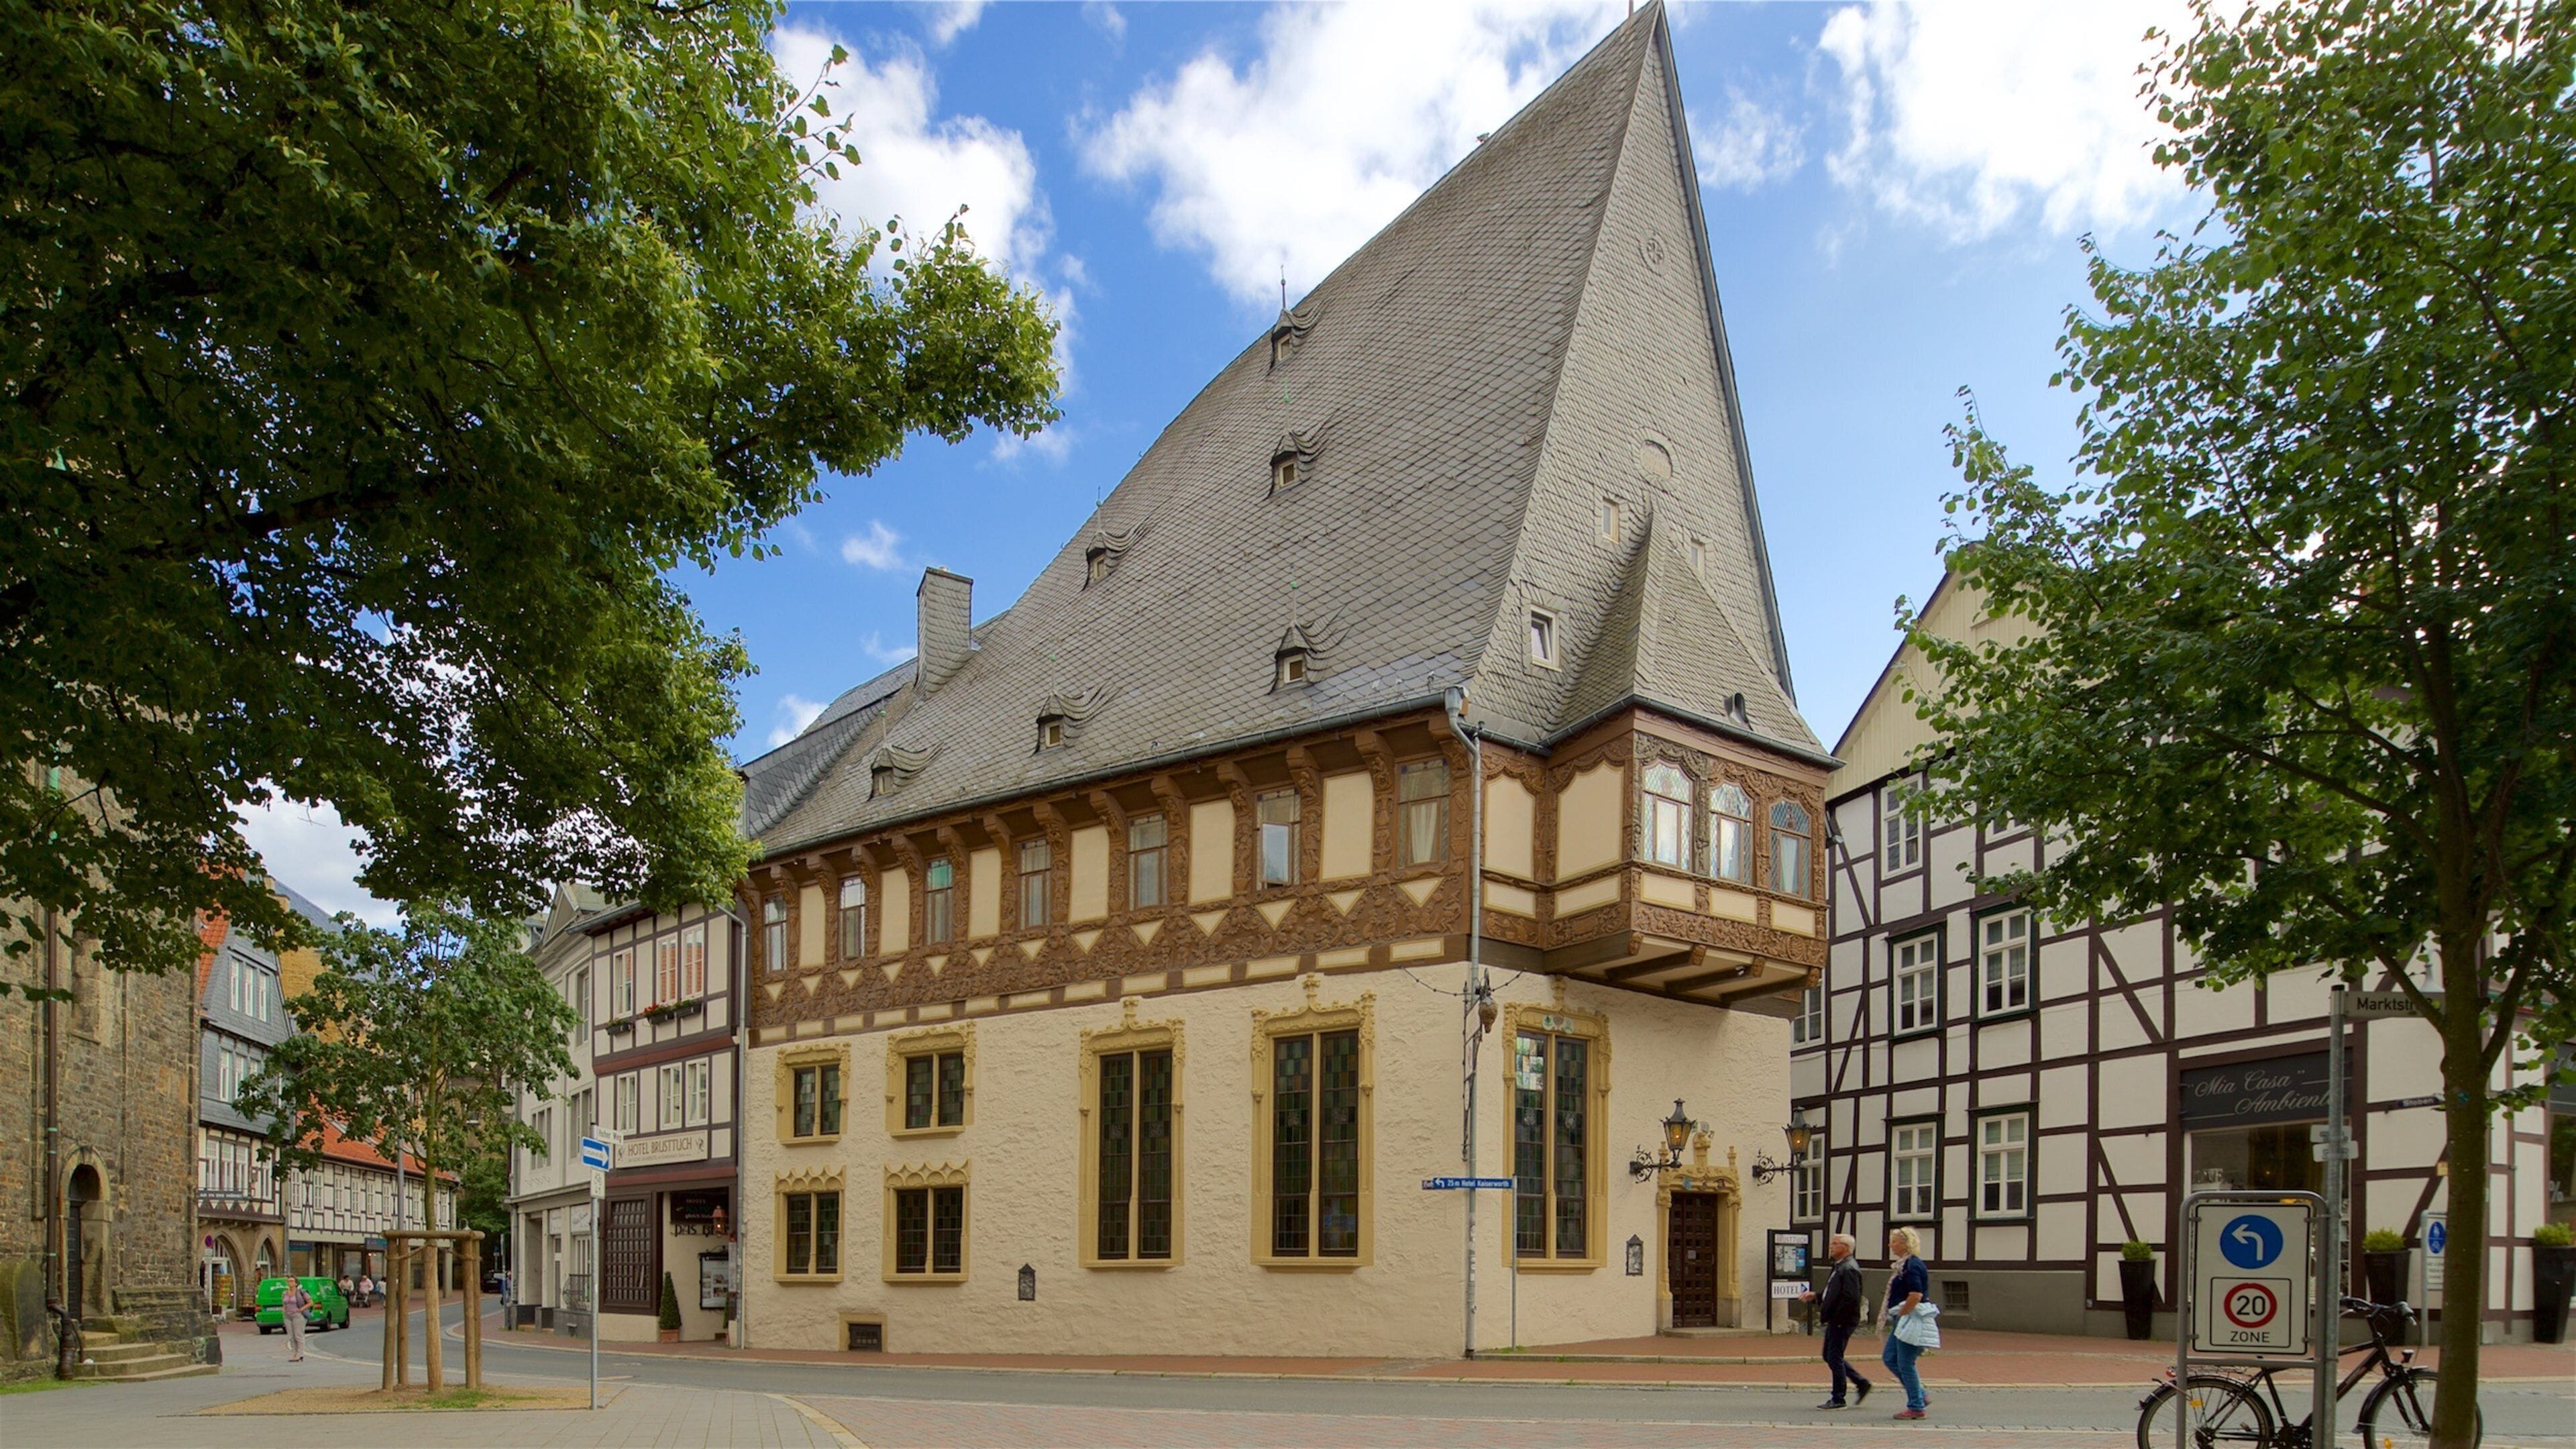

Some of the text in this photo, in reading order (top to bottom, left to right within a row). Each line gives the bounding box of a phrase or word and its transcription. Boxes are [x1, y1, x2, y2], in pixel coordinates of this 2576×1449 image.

[2357, 996, 2435, 1011] Marktstr
[2235, 1089, 2330, 1115] Ambient
[628, 1137, 692, 1156] HOTEL BRUSTTUCH
[1773, 1285, 1799, 1295] HOTEL
[2236, 1295, 2266, 1316] 20
[2230, 1331, 2270, 1343] ZONE
